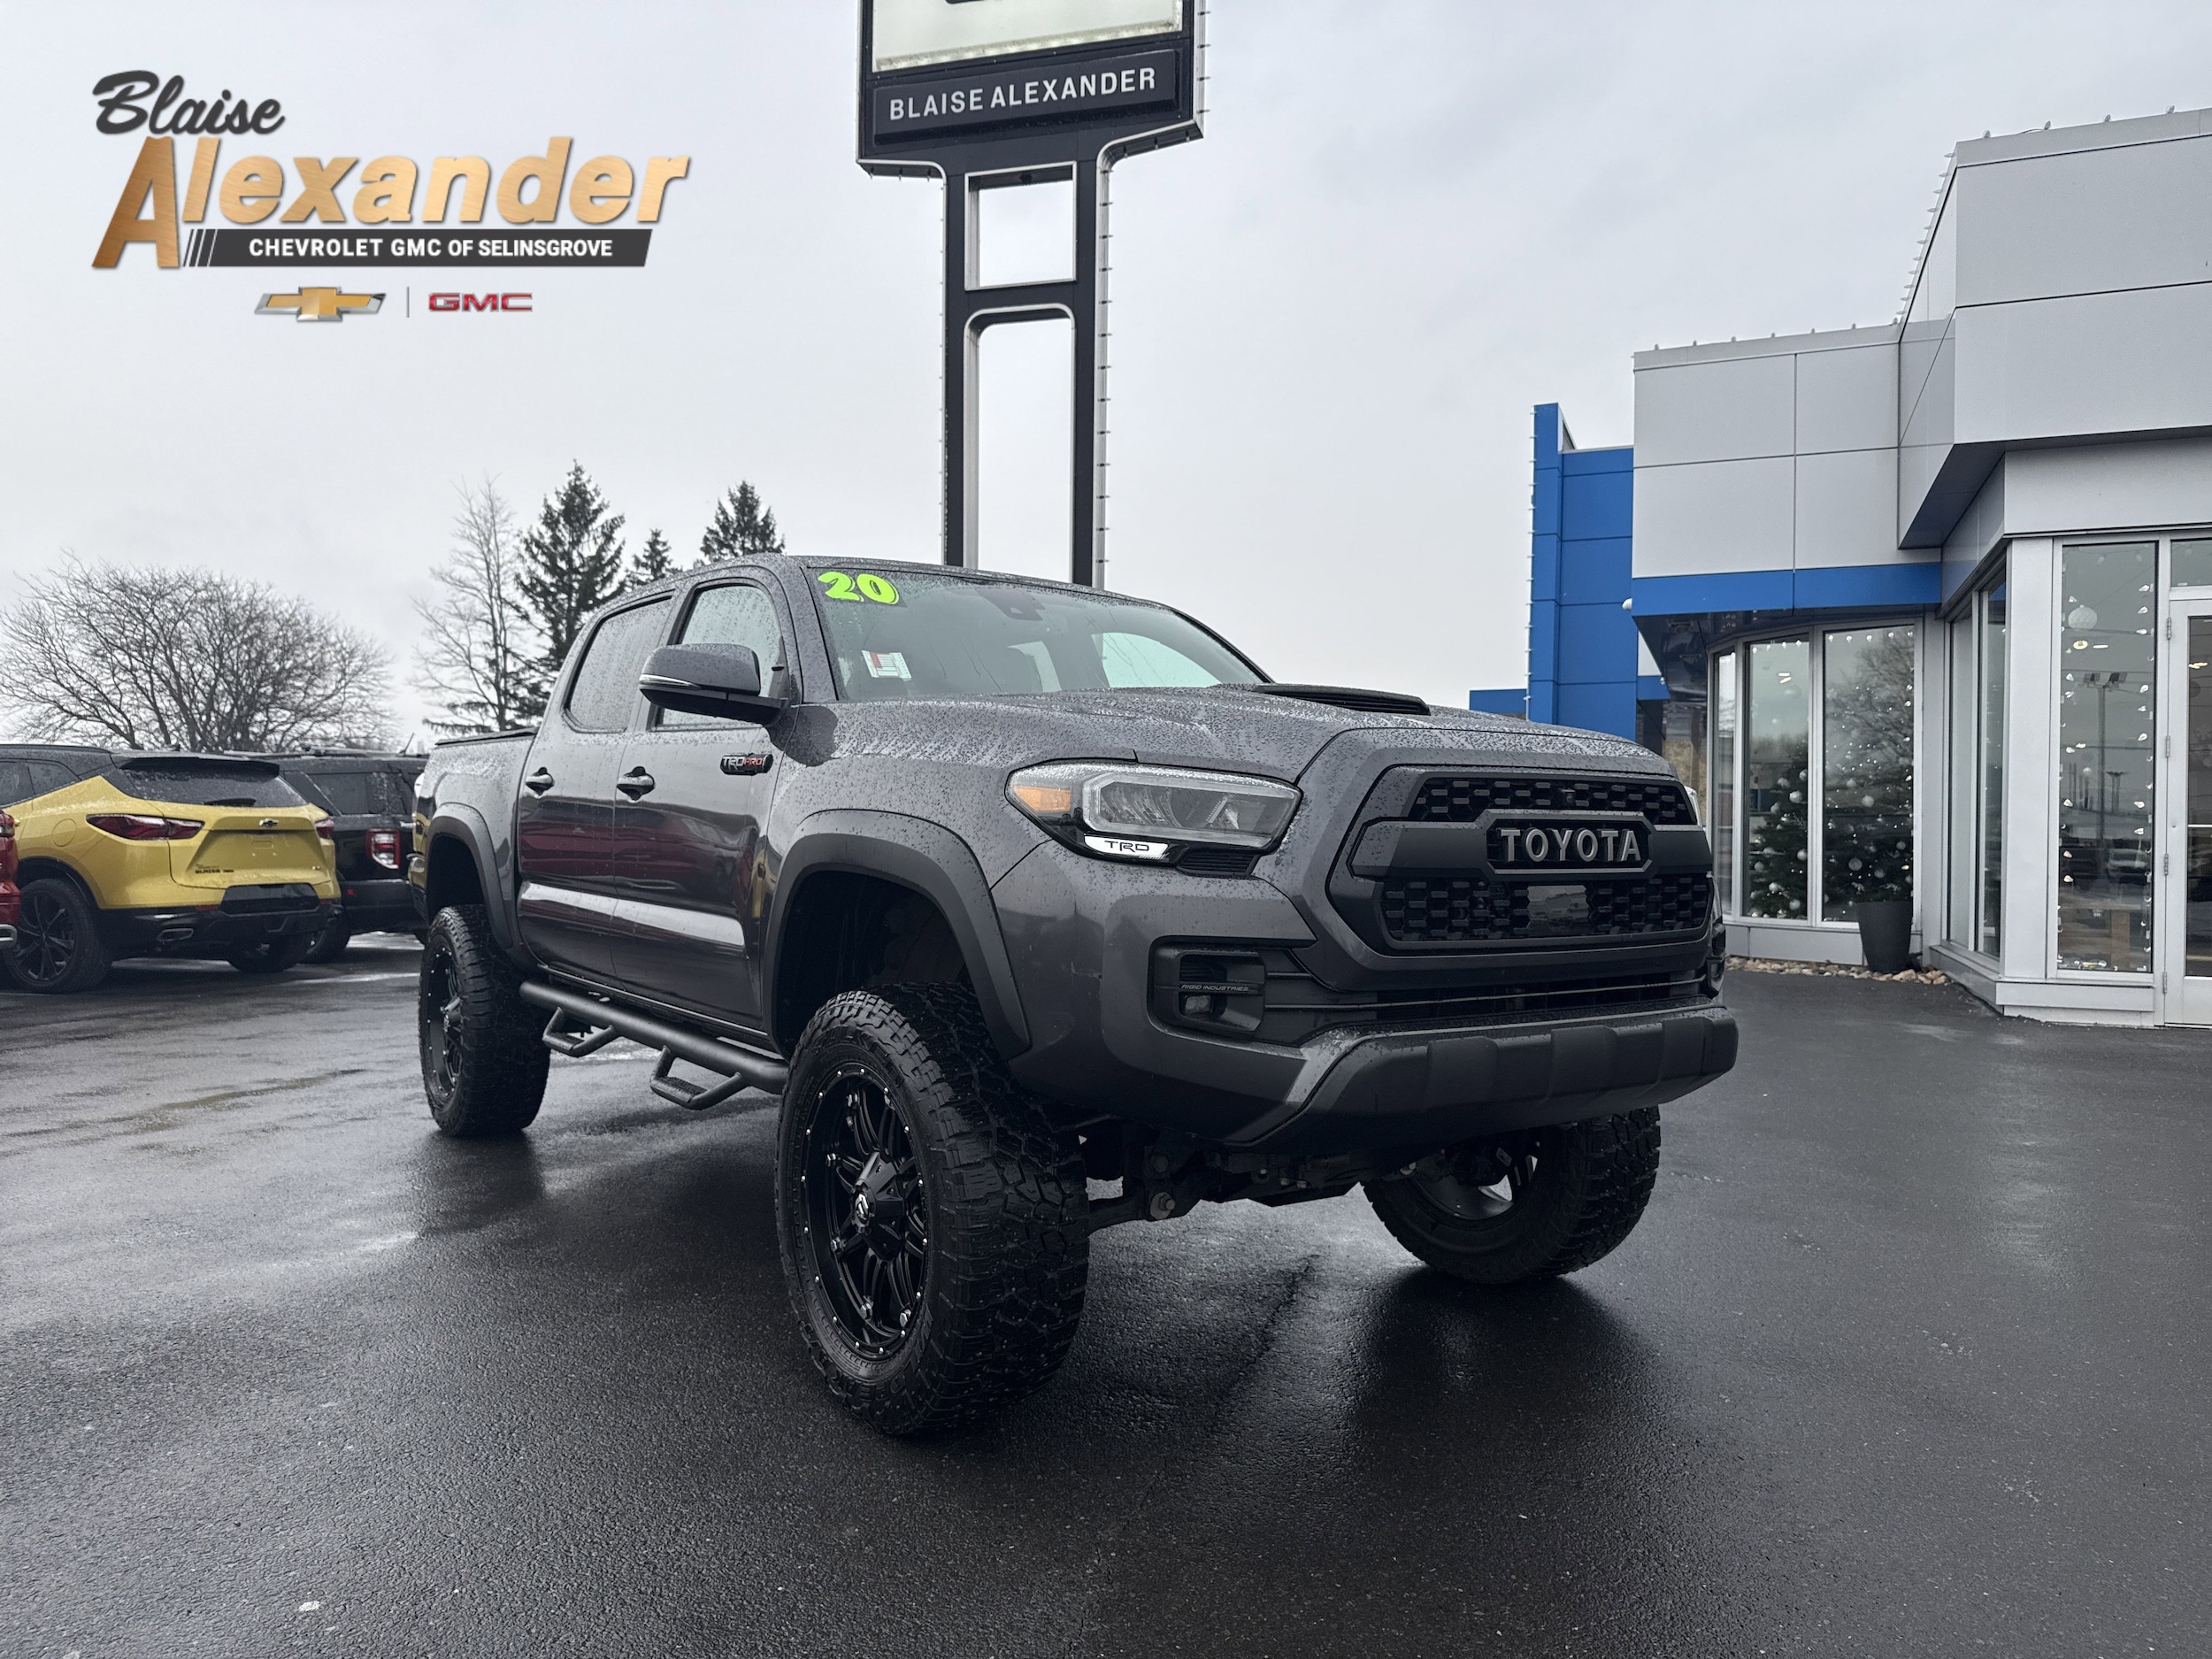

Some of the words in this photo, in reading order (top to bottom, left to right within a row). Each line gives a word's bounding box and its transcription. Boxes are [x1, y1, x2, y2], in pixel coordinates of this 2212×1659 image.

[889, 88, 984, 121] BLAISE
[990, 66, 1156, 110] ALEXANDER
[818, 572, 900, 605] 20
[722, 756, 745, 770] TRD
[743, 757, 764, 766] PRO
[1104, 840, 1150, 853] TRD
[1500, 827, 1641, 863] TOYOTA
